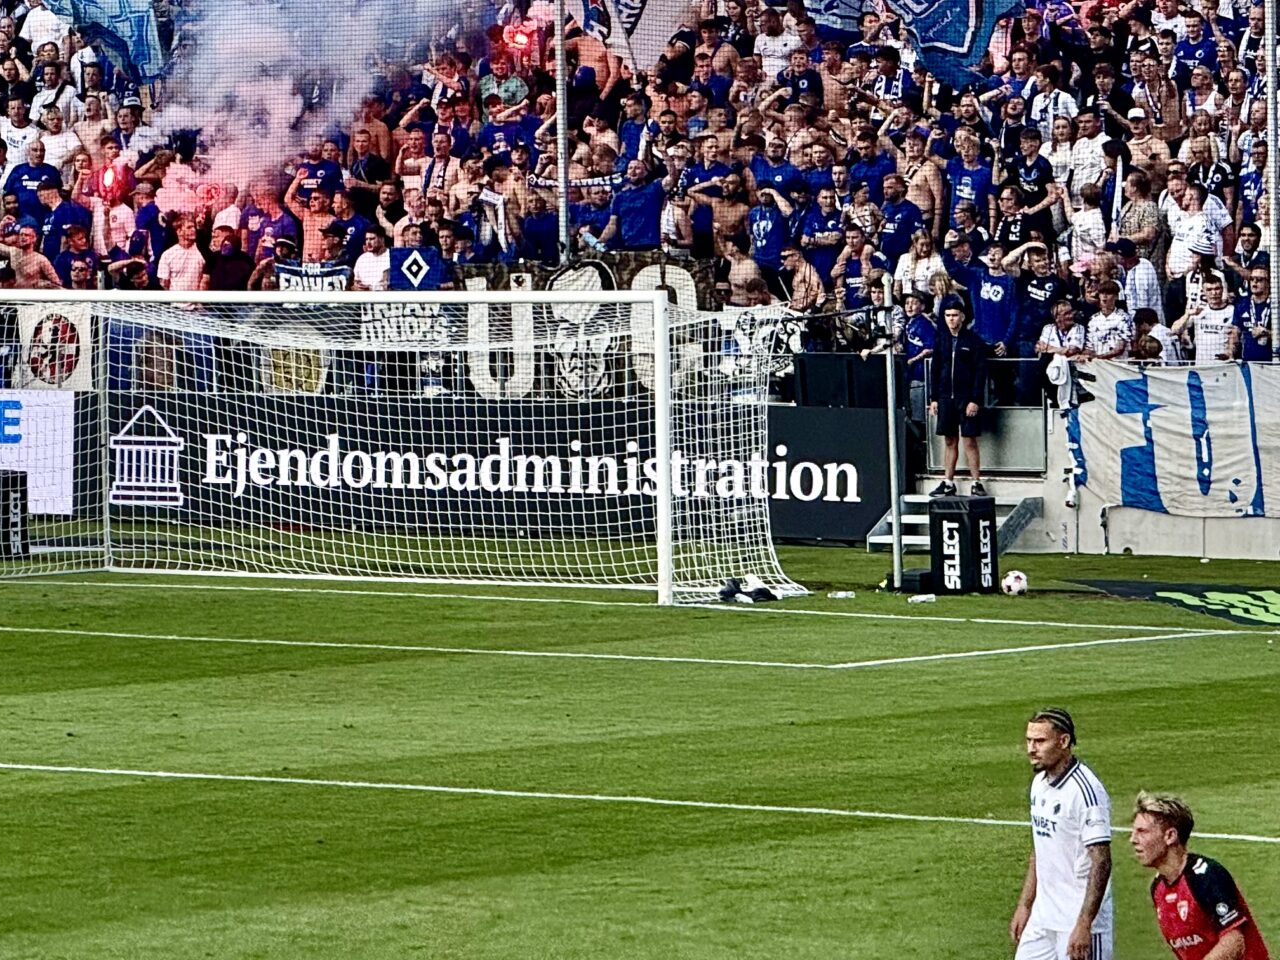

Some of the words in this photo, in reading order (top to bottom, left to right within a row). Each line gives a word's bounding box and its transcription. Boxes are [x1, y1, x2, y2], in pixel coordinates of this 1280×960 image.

[202, 431, 862, 503] Ejendomsadministration
[942, 519, 962, 591] SELECT
[979, 519, 994, 589] SELECT
